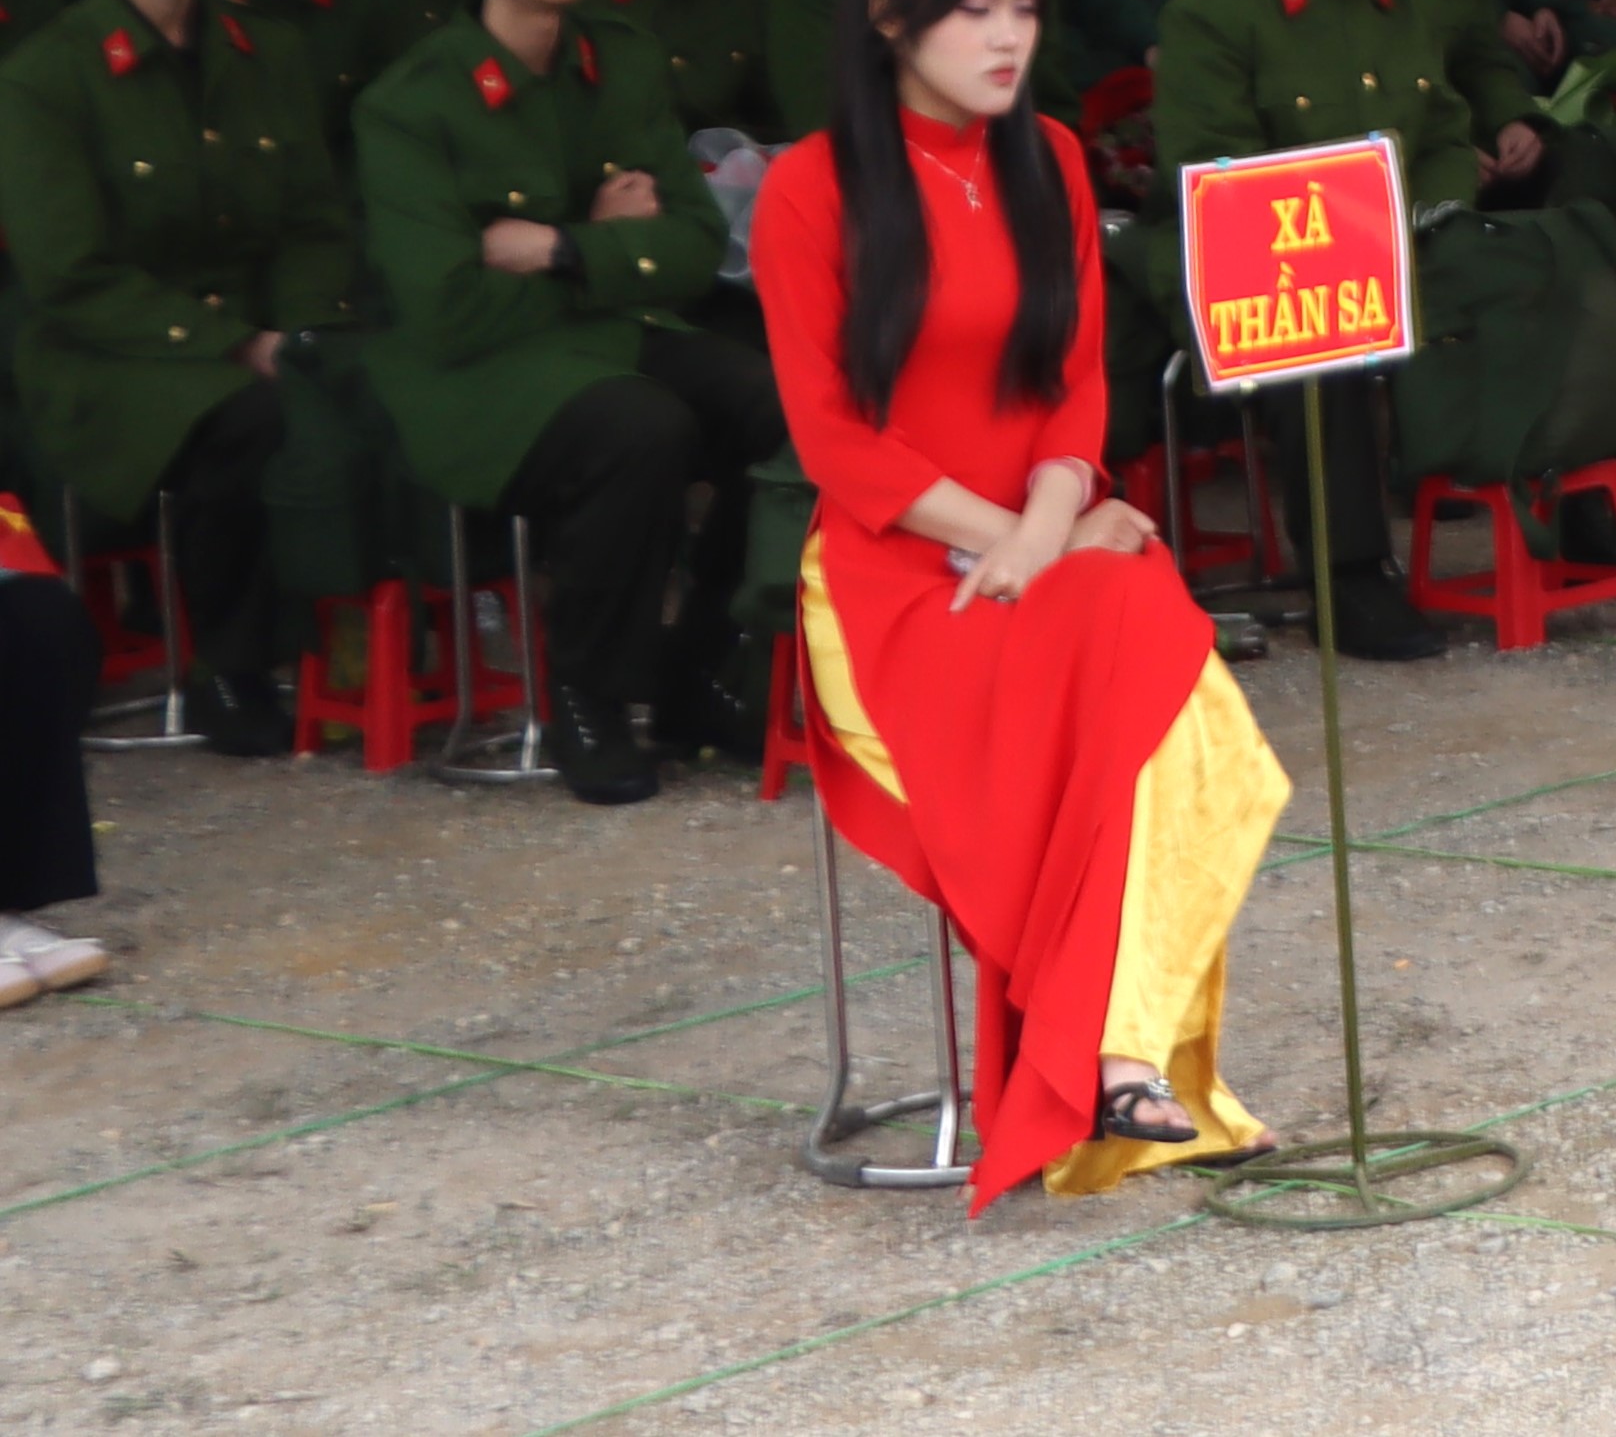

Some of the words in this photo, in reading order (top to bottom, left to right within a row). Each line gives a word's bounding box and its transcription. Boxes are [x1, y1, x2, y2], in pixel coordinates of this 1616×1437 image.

[1269, 181, 1334, 253] XÃ
[1210, 261, 1330, 354] THẦN
[1337, 275, 1390, 333] SA
